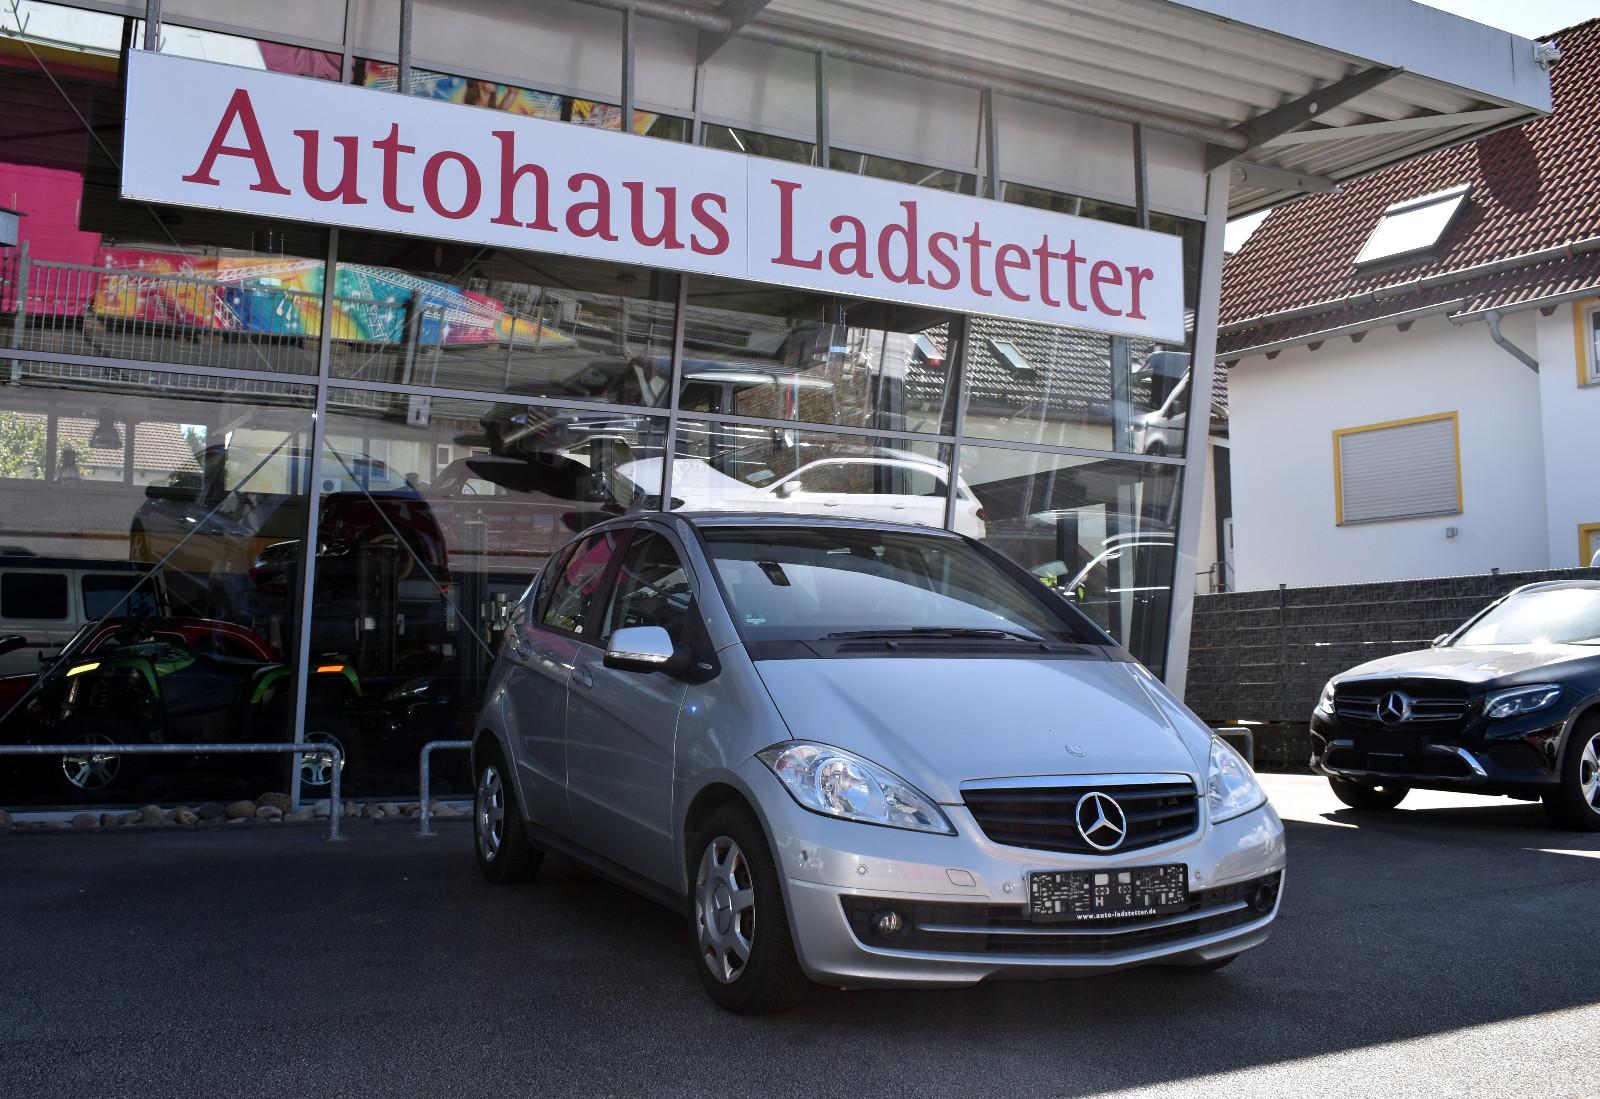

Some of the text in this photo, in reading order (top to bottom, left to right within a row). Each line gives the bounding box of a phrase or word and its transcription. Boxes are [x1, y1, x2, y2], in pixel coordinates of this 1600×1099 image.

[182, 88, 1154, 321] Autohaus Ladstetter
[1076, 908, 1156, 920] www.auto-ladstetter.de
